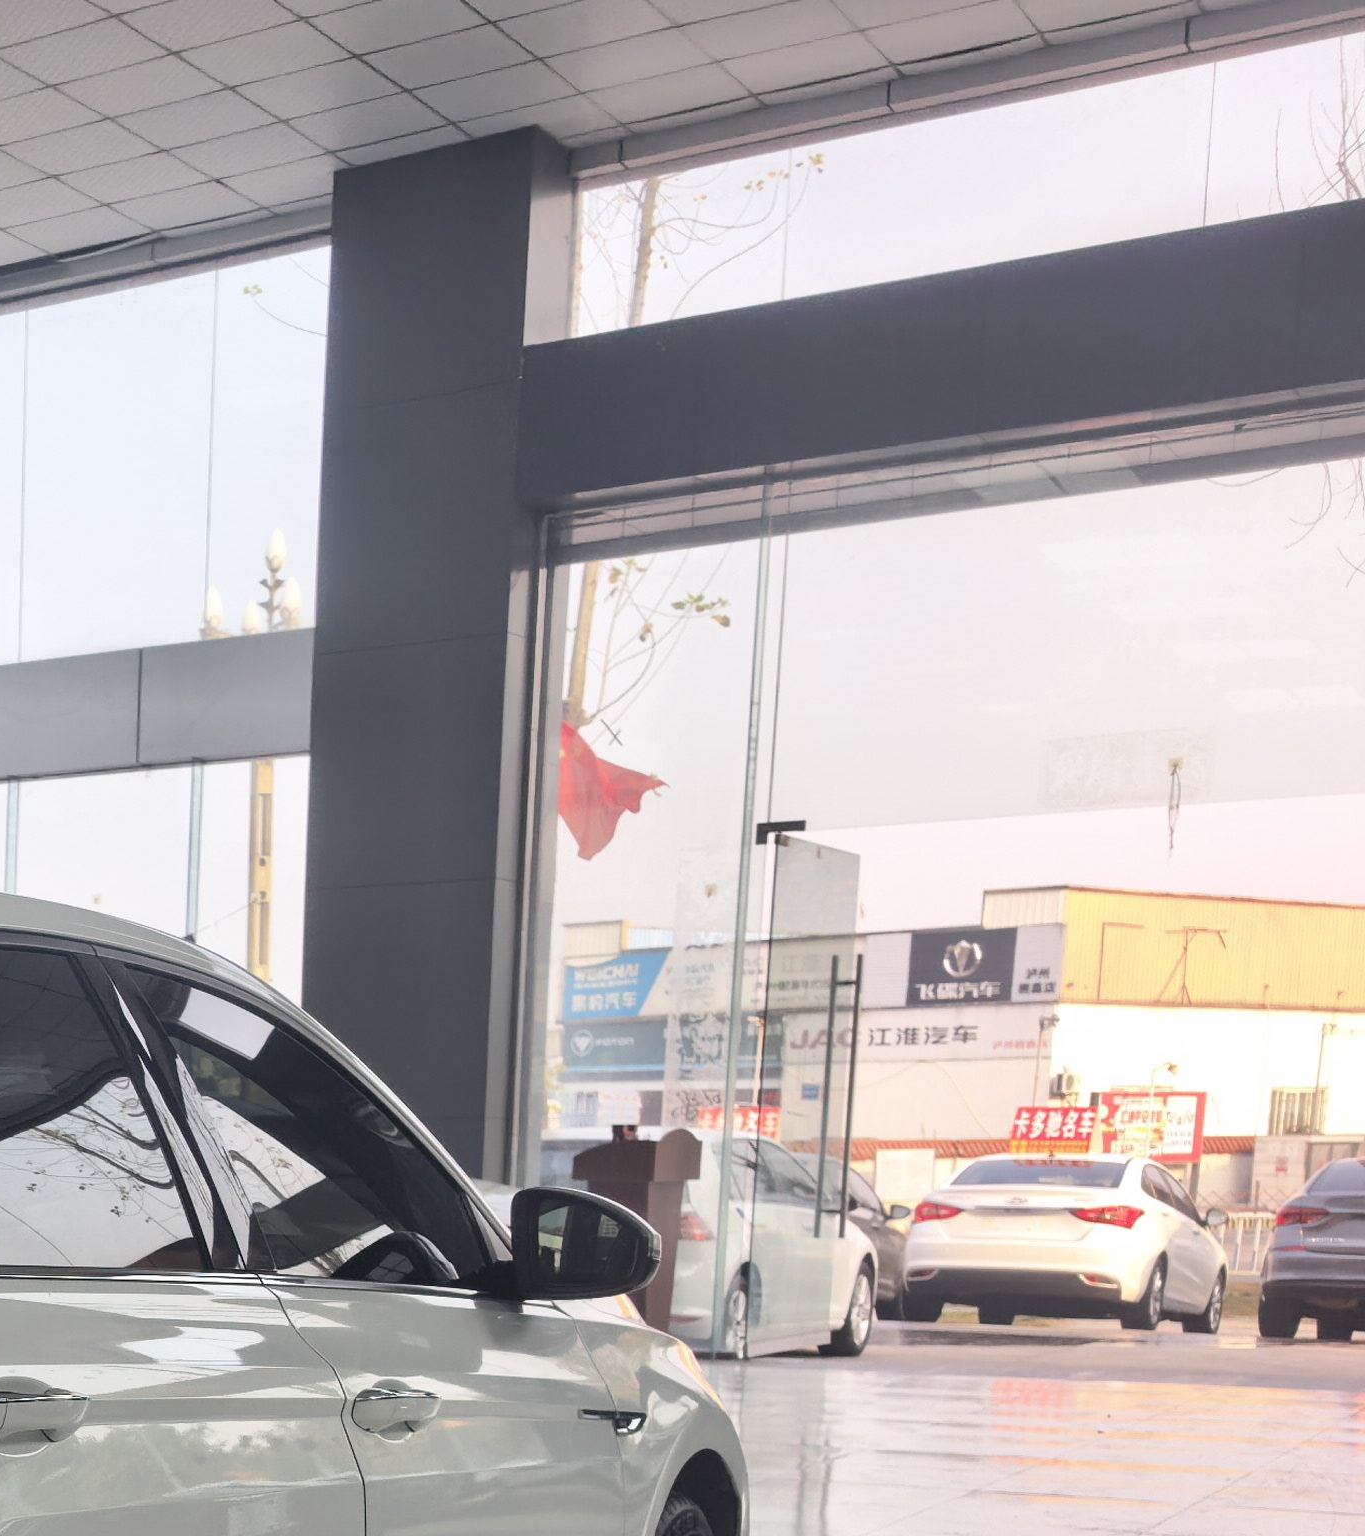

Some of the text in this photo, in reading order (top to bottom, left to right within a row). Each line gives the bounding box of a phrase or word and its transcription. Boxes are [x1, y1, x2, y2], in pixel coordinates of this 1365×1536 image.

[914, 981, 1002, 1001] 飞碟汽车
[789, 1028, 858, 1050] JAC
[867, 1025, 979, 1047] 江淮汽车
[1014, 1109, 1096, 1139] 卡多驰名车
